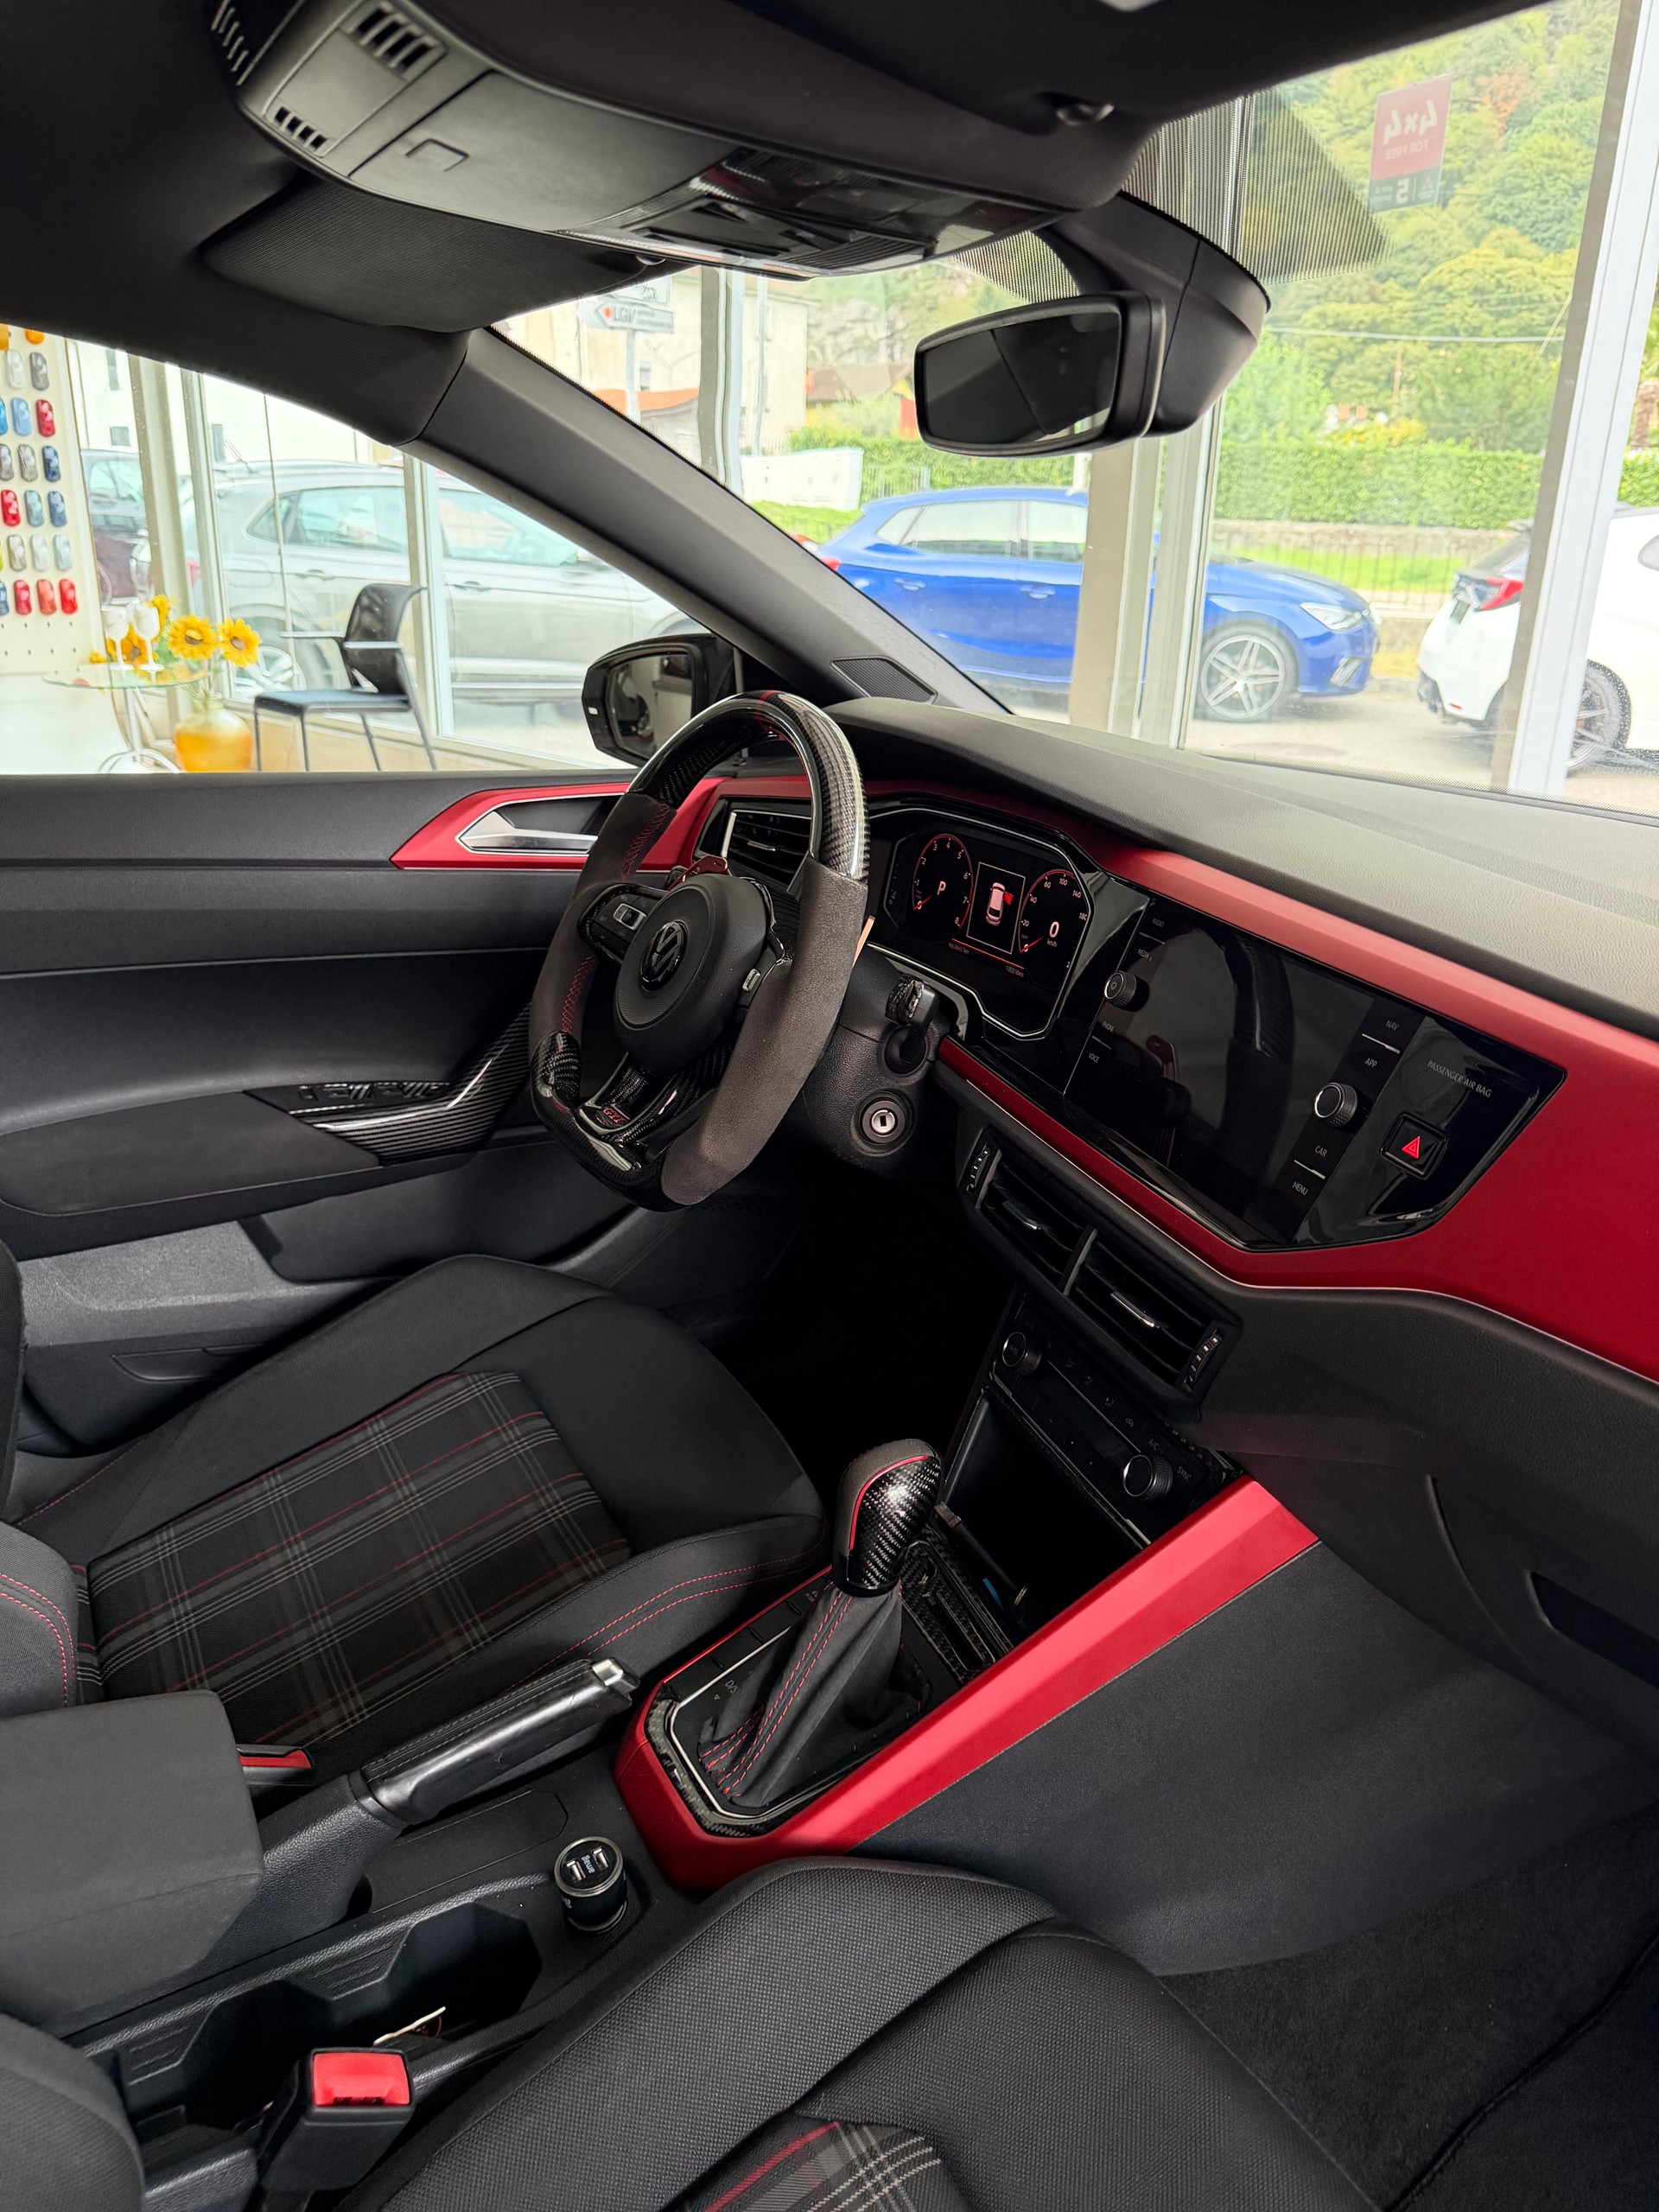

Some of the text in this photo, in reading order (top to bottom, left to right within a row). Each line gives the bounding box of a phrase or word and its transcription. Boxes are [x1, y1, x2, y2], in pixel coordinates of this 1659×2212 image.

[921, 857, 926, 866] 2
[957, 851, 962, 860] 5
[937, 880, 947, 895] P
[1058, 878, 1068, 887] 100
[1072, 890, 1082, 899] 140
[1152, 917, 1165, 928] RADIO
[1049, 921, 1059, 938] 0
[1137, 948, 1149, 959] MEDIA
[1102, 1020, 1116, 1033] PHONE
[1385, 1020, 1400, 1031] NAV
[1088, 1052, 1100, 1064] VOICE
[1364, 1057, 1377, 1068] APP
[1427, 1059, 1492, 1098] PASSENGER AIR BAG
[603, 1107, 624, 1124] GTI
[1314, 1145, 1327, 1158] CAR
[1292, 1180, 1308, 1196] MENU
[1177, 1465, 1192, 1483] SYNC
